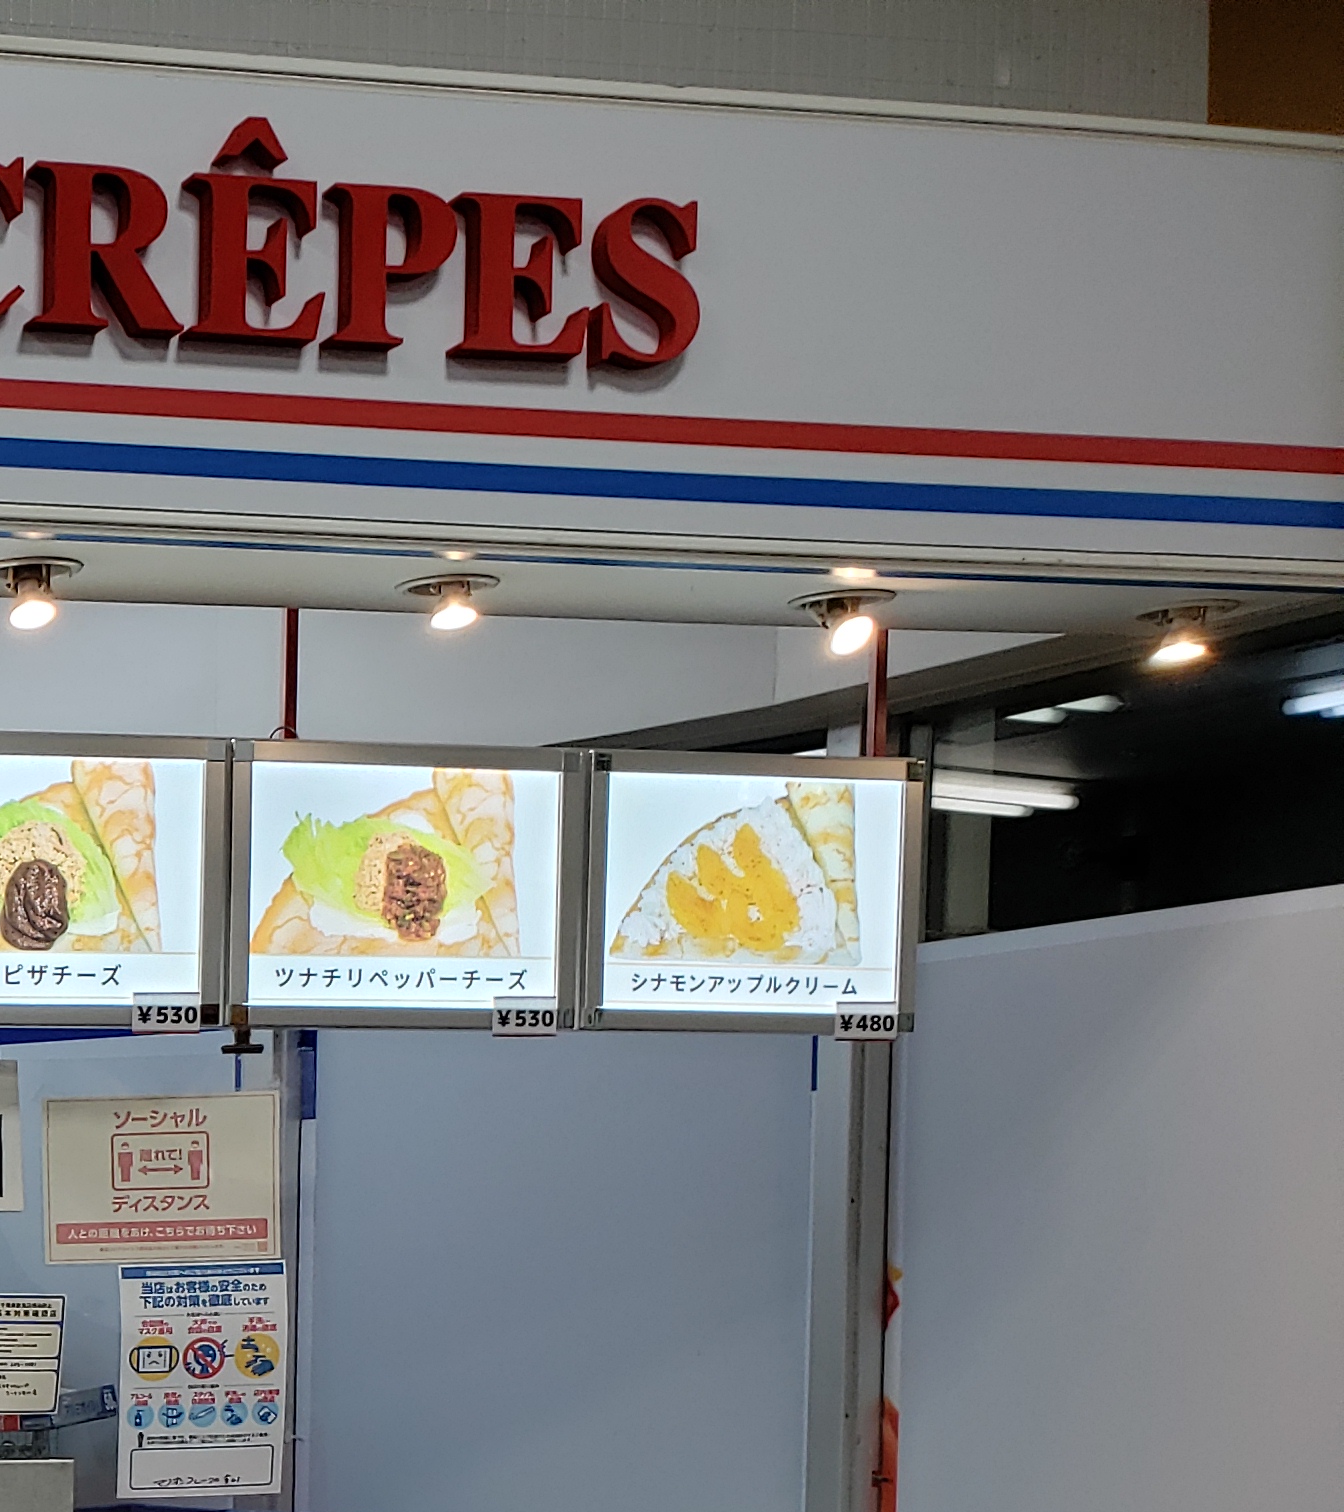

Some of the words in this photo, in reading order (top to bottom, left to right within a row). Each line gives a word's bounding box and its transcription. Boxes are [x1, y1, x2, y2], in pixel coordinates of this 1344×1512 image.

[274, 963, 528, 994] ツナチリペッパーチーズ
[630, 971, 859, 998] シナモンアップルクリーム
[136, 1003, 199, 1027] ¥530
[496, 1006, 556, 1031] ¥530
[837, 1011, 896, 1035] ¥480
[113, 1108, 207, 1129] ソーシャル
[111, 1194, 210, 1213] ディスタンス
